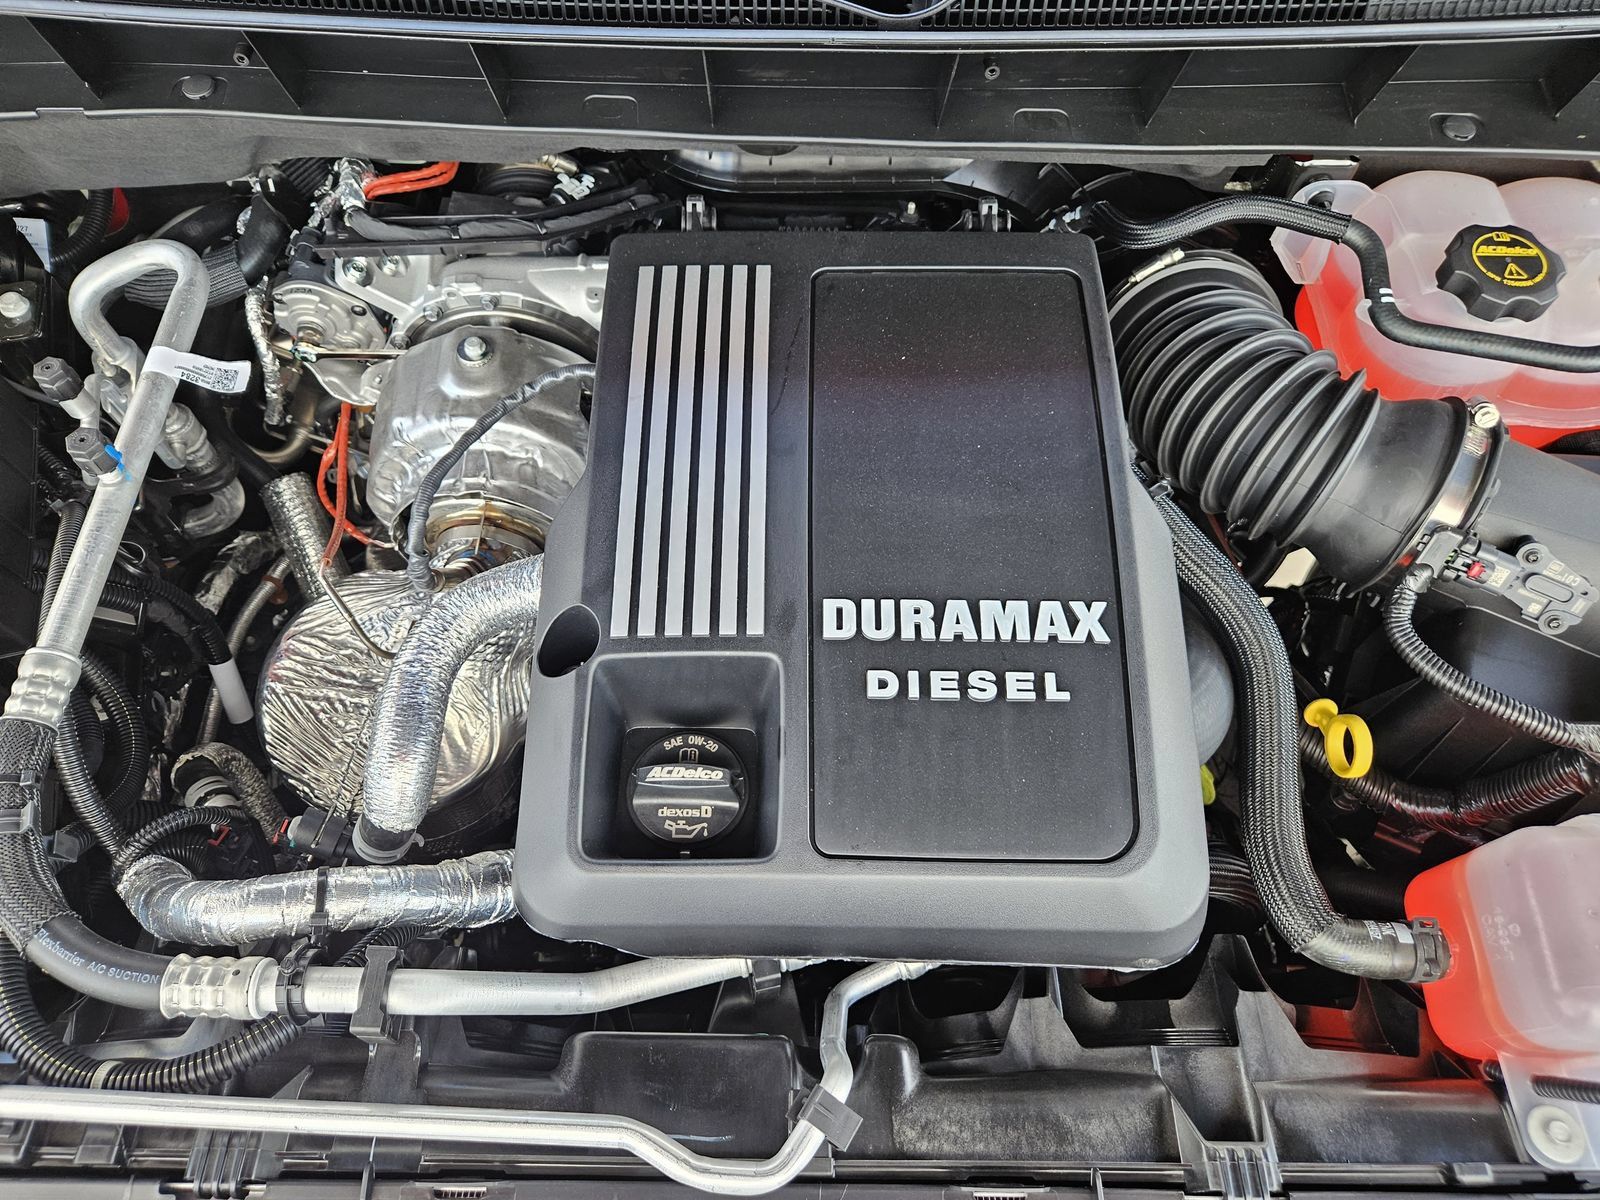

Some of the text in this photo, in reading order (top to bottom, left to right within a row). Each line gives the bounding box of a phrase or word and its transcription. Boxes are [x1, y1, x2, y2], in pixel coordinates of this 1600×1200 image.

[1476, 244, 1538, 255] ACDelco
[180, 371, 201, 384] 3284
[822, 598, 1111, 645] DURAMAX
[866, 669, 1071, 702] DIESEL
[663, 735, 719, 753] SAE 0W-20
[646, 766, 724, 780] ACDelco
[33, 928, 160, 984] Flexbarrier A/C SUCTION
